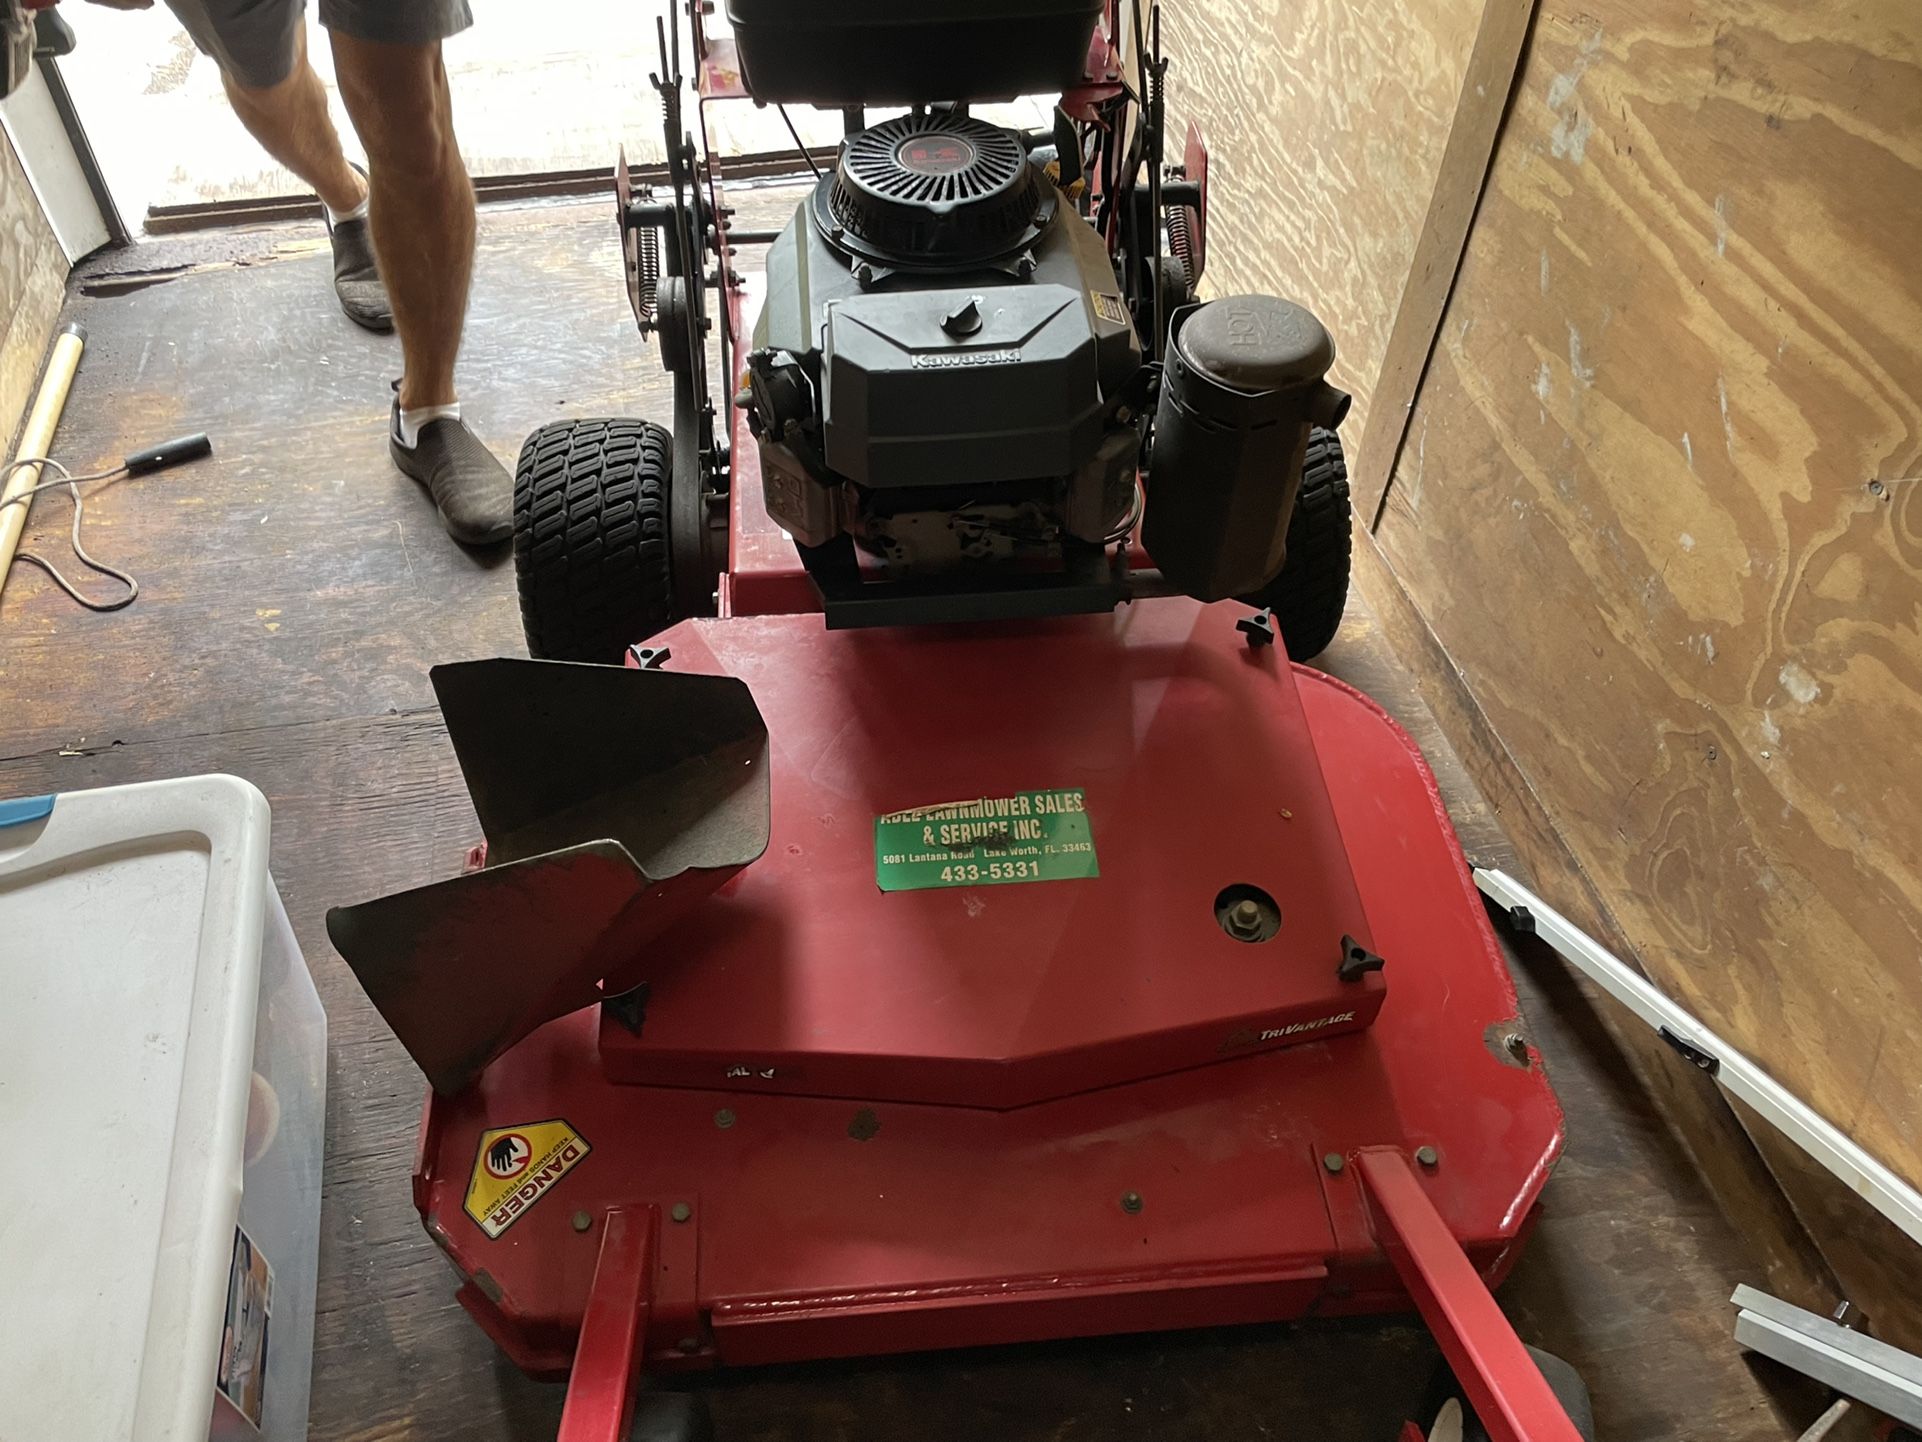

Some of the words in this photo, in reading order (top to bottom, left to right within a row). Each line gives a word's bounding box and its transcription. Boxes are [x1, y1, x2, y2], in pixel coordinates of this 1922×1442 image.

[910, 347, 1022, 369] Kawasaki
[1034, 792, 1085, 815] SALES
[922, 825, 936, 847] &
[940, 820, 1009, 846] SERVICE
[1012, 818, 1049, 840] INC.
[883, 854, 905, 865] 5081
[908, 852, 948, 863] Lantana
[1009, 845, 1042, 856] Worth,
[1044, 844, 1060, 854] FL.
[940, 860, 1039, 882] 433-5331
[551, 1136, 569, 1154] KEEP
[529, 1151, 553, 1174] HANDS
[491, 1143, 581, 1227] DANGER
[501, 1183, 519, 1201] FEET
[482, 1198, 501, 1217] AWAY
